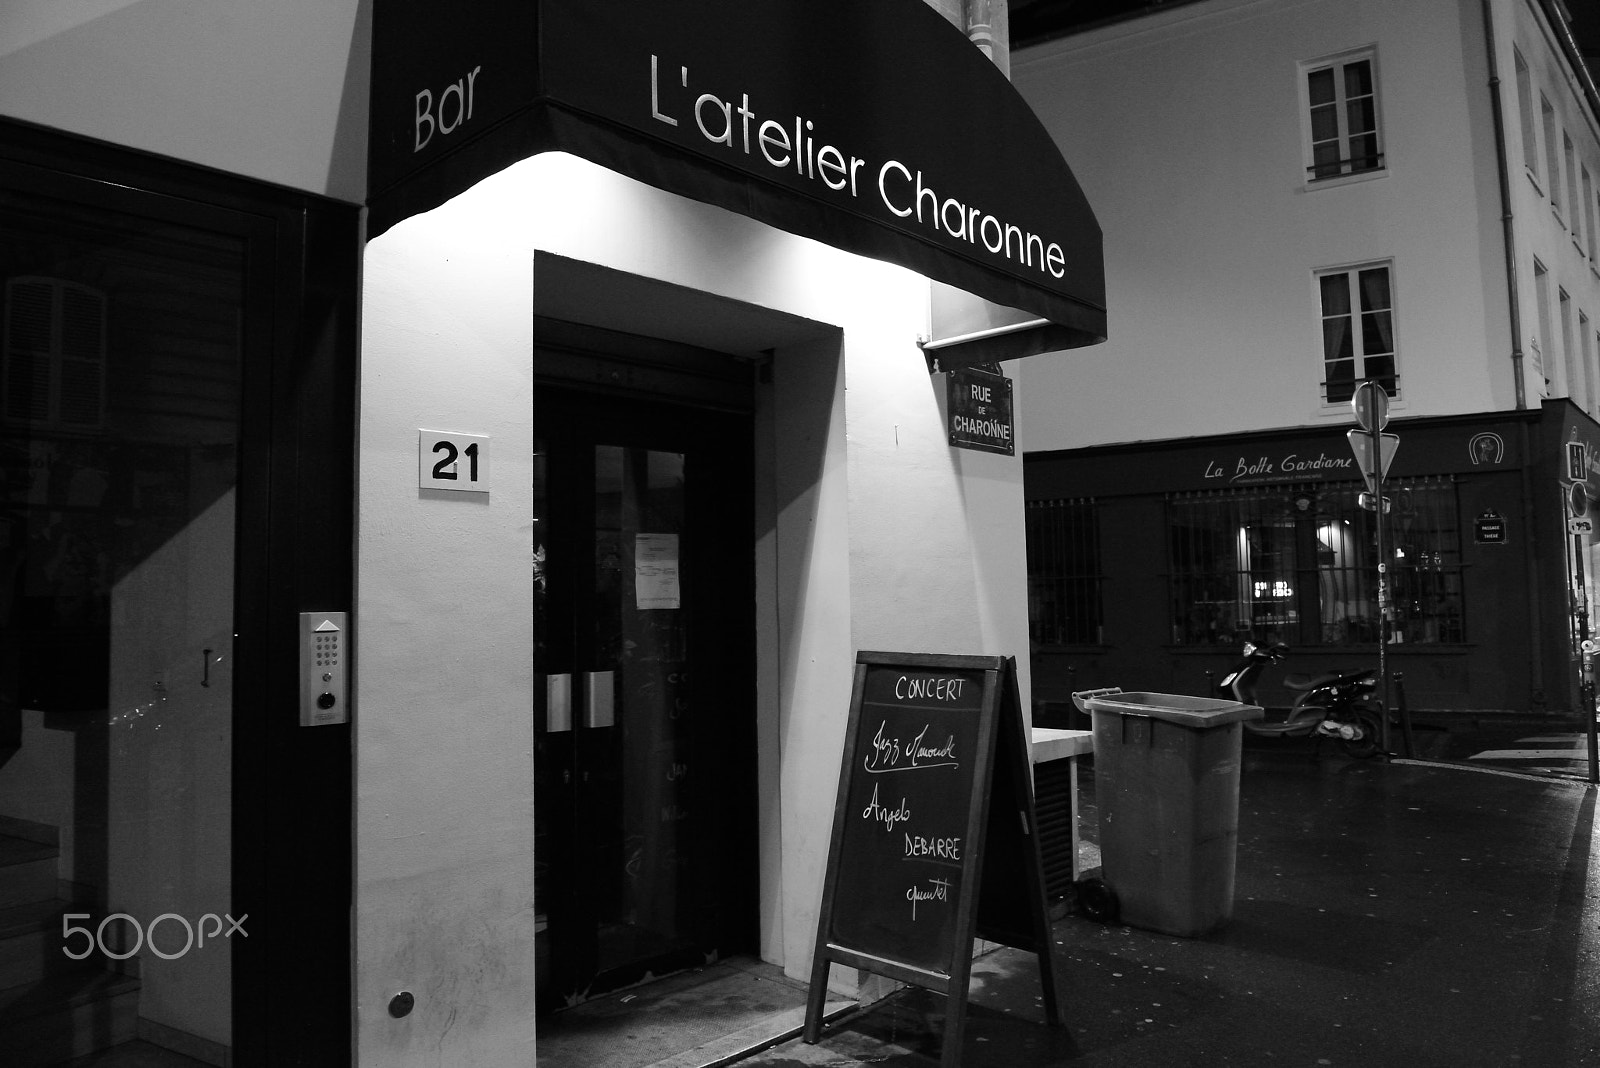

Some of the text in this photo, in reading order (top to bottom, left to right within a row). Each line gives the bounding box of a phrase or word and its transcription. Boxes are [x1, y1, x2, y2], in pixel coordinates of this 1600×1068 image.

[413, 64, 482, 154] Bar
[650, 54, 1067, 280] L'atelier Charonne
[971, 384, 992, 403] RUE
[978, 406, 986, 415] DE
[954, 415, 1010, 440] CHARONNE
[431, 440, 479, 482] 21
[1204, 453, 1352, 484] La Botte Gardiane
[895, 675, 967, 702] CONCERT
[866, 719, 901, 769] Jazz
[862, 781, 911, 832] Angelo
[904, 831, 961, 861] DEBARRE
